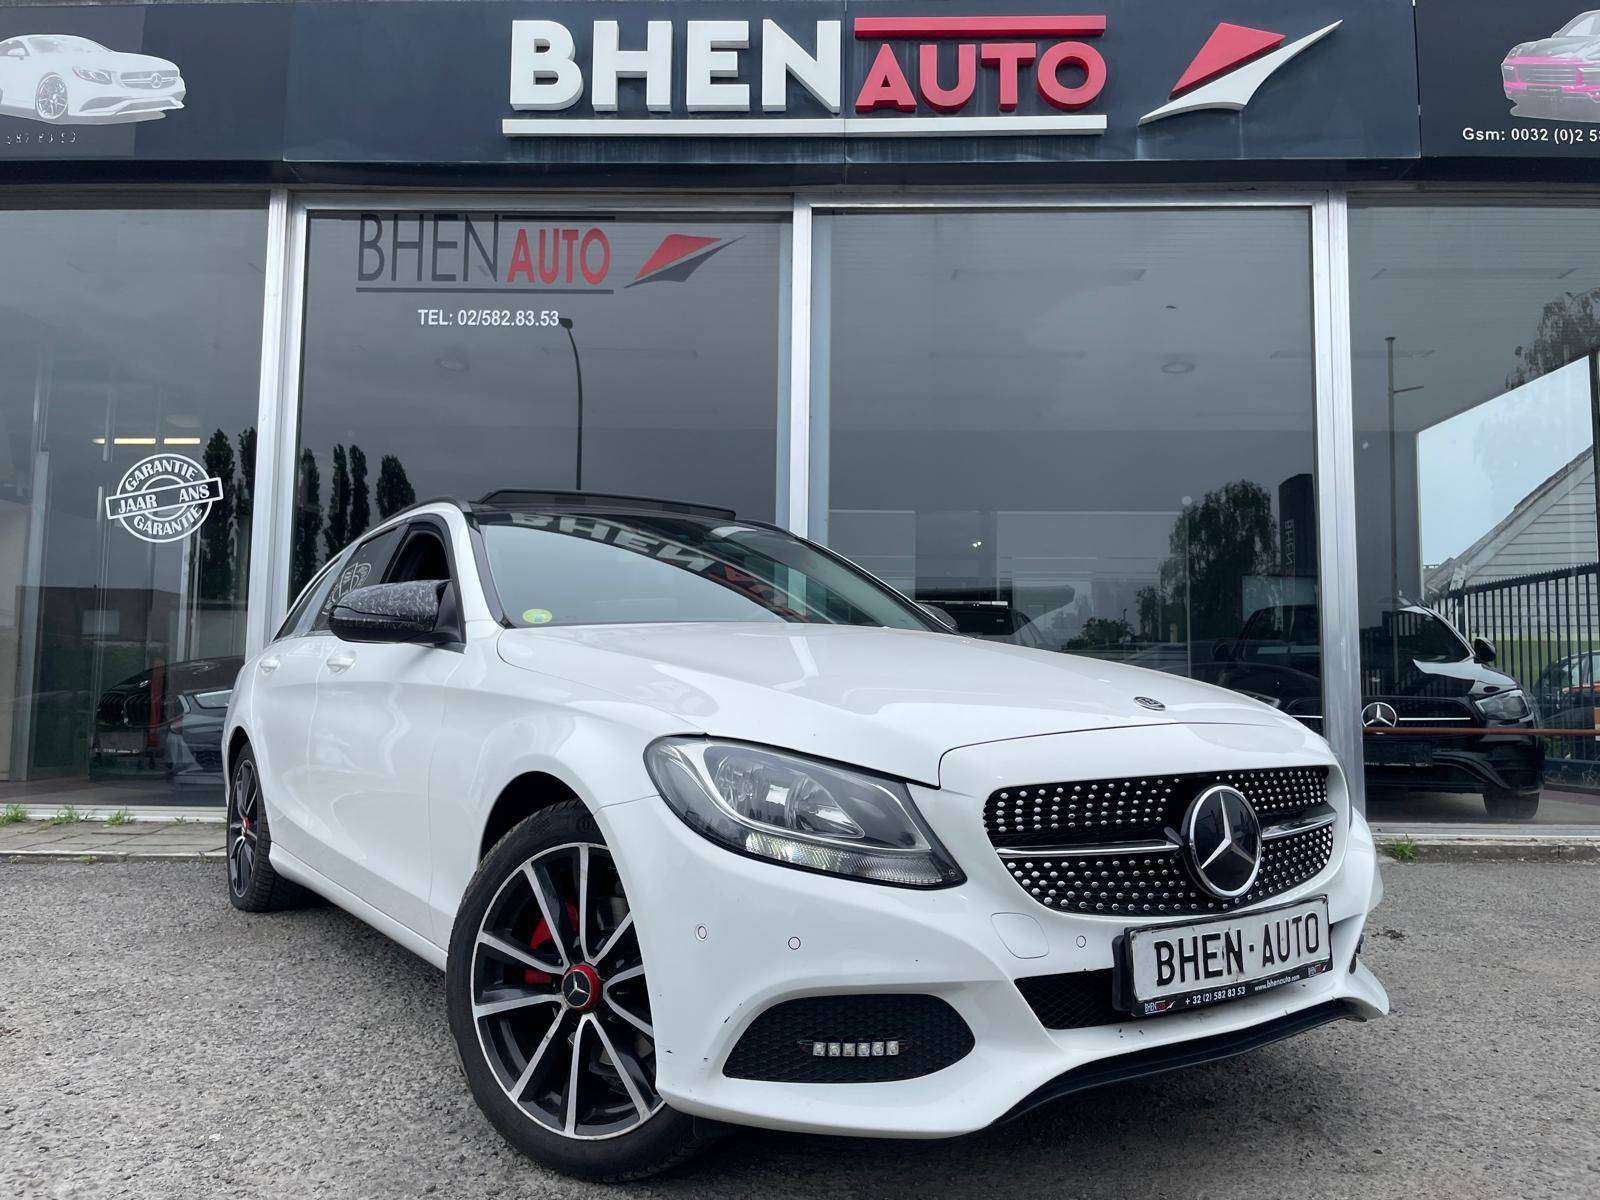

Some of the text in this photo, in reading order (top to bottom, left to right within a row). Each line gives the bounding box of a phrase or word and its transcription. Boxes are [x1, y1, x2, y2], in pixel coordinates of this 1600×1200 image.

[510, 19, 1107, 113] BHEN AUTO
[1462, 127, 1600, 145] Gsm: 0032 (0)2 5
[357, 213, 612, 285] BHEN AUTO
[417, 309, 560, 327] TEL: 02/582.83.53
[125, 459, 198, 491] GARANTIE
[118, 484, 210, 514] JAAR ANS
[133, 504, 202, 536] GARANTIE
